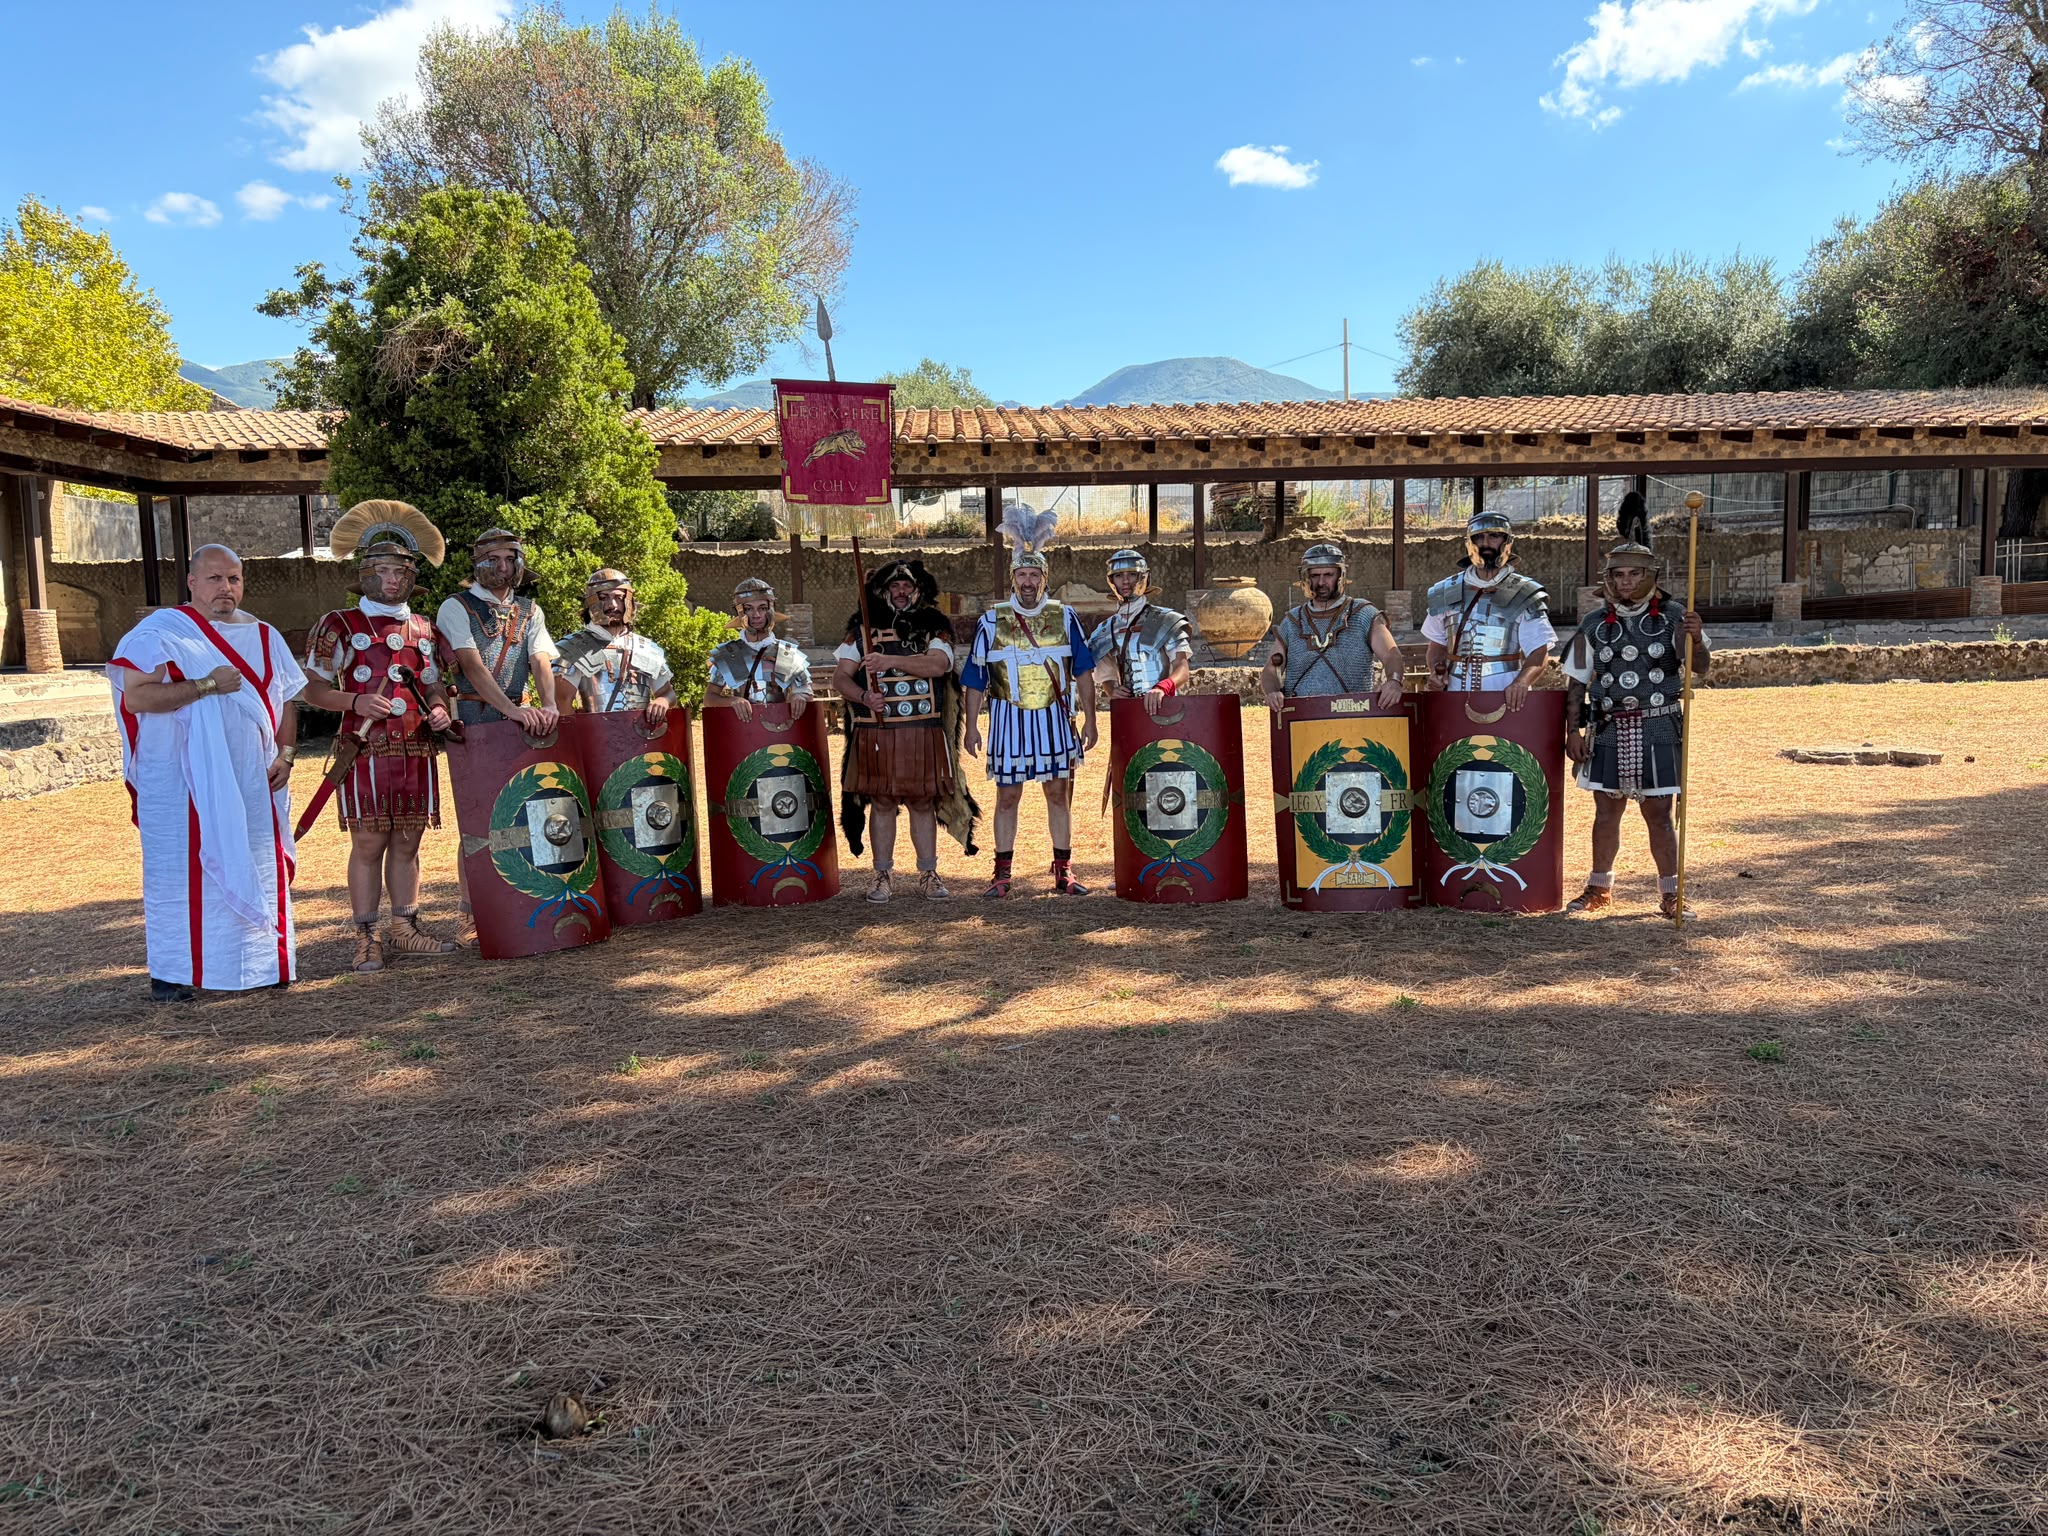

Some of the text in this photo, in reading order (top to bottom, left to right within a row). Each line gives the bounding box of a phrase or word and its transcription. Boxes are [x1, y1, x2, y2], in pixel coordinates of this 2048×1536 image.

[790, 402, 879, 420] LEG X FRE
[813, 479, 858, 493] COH V
[1291, 792, 1408, 811] LEG X FR
